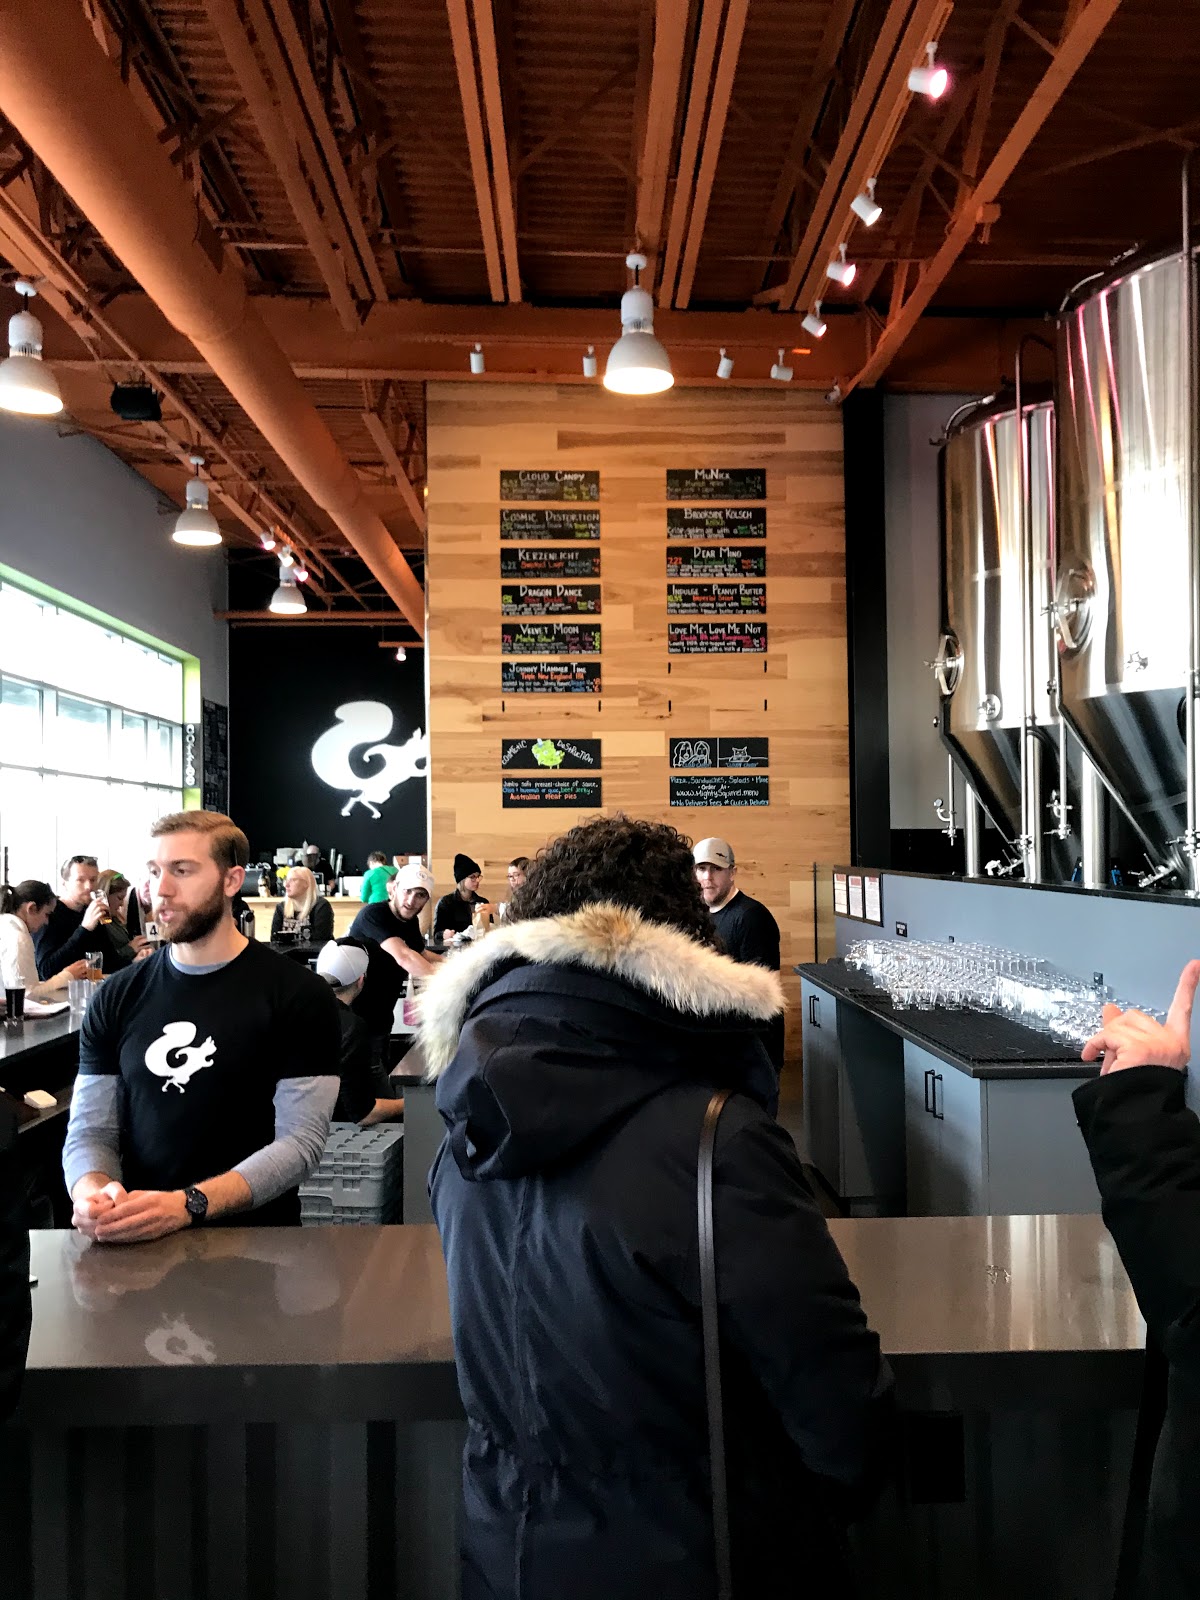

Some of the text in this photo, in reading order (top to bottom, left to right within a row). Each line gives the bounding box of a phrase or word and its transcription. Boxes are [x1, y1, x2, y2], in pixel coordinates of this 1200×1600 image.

[519, 470, 585, 482] CLOUD CANDY
[503, 510, 599, 522] COSMIC DISTORTION
[518, 549, 580, 560] KERZENLICHT
[694, 547, 741, 558] DEAR MIND
[520, 585, 582, 597] DRAGON DANCE
[672, 584, 699, 595] INDULGE
[712, 585, 737, 595] PEANUT
[739, 584, 763, 595] BUTTER
[520, 624, 579, 634] VELVET MOON
[669, 624, 687, 634] LOVE
[709, 623, 725, 634] LOVE
[728, 623, 740, 634] ME
[745, 623, 761, 634] NOT
[509, 662, 587, 673] JOHNNY HAMMER TIME
[150, 925, 158, 936] 4
